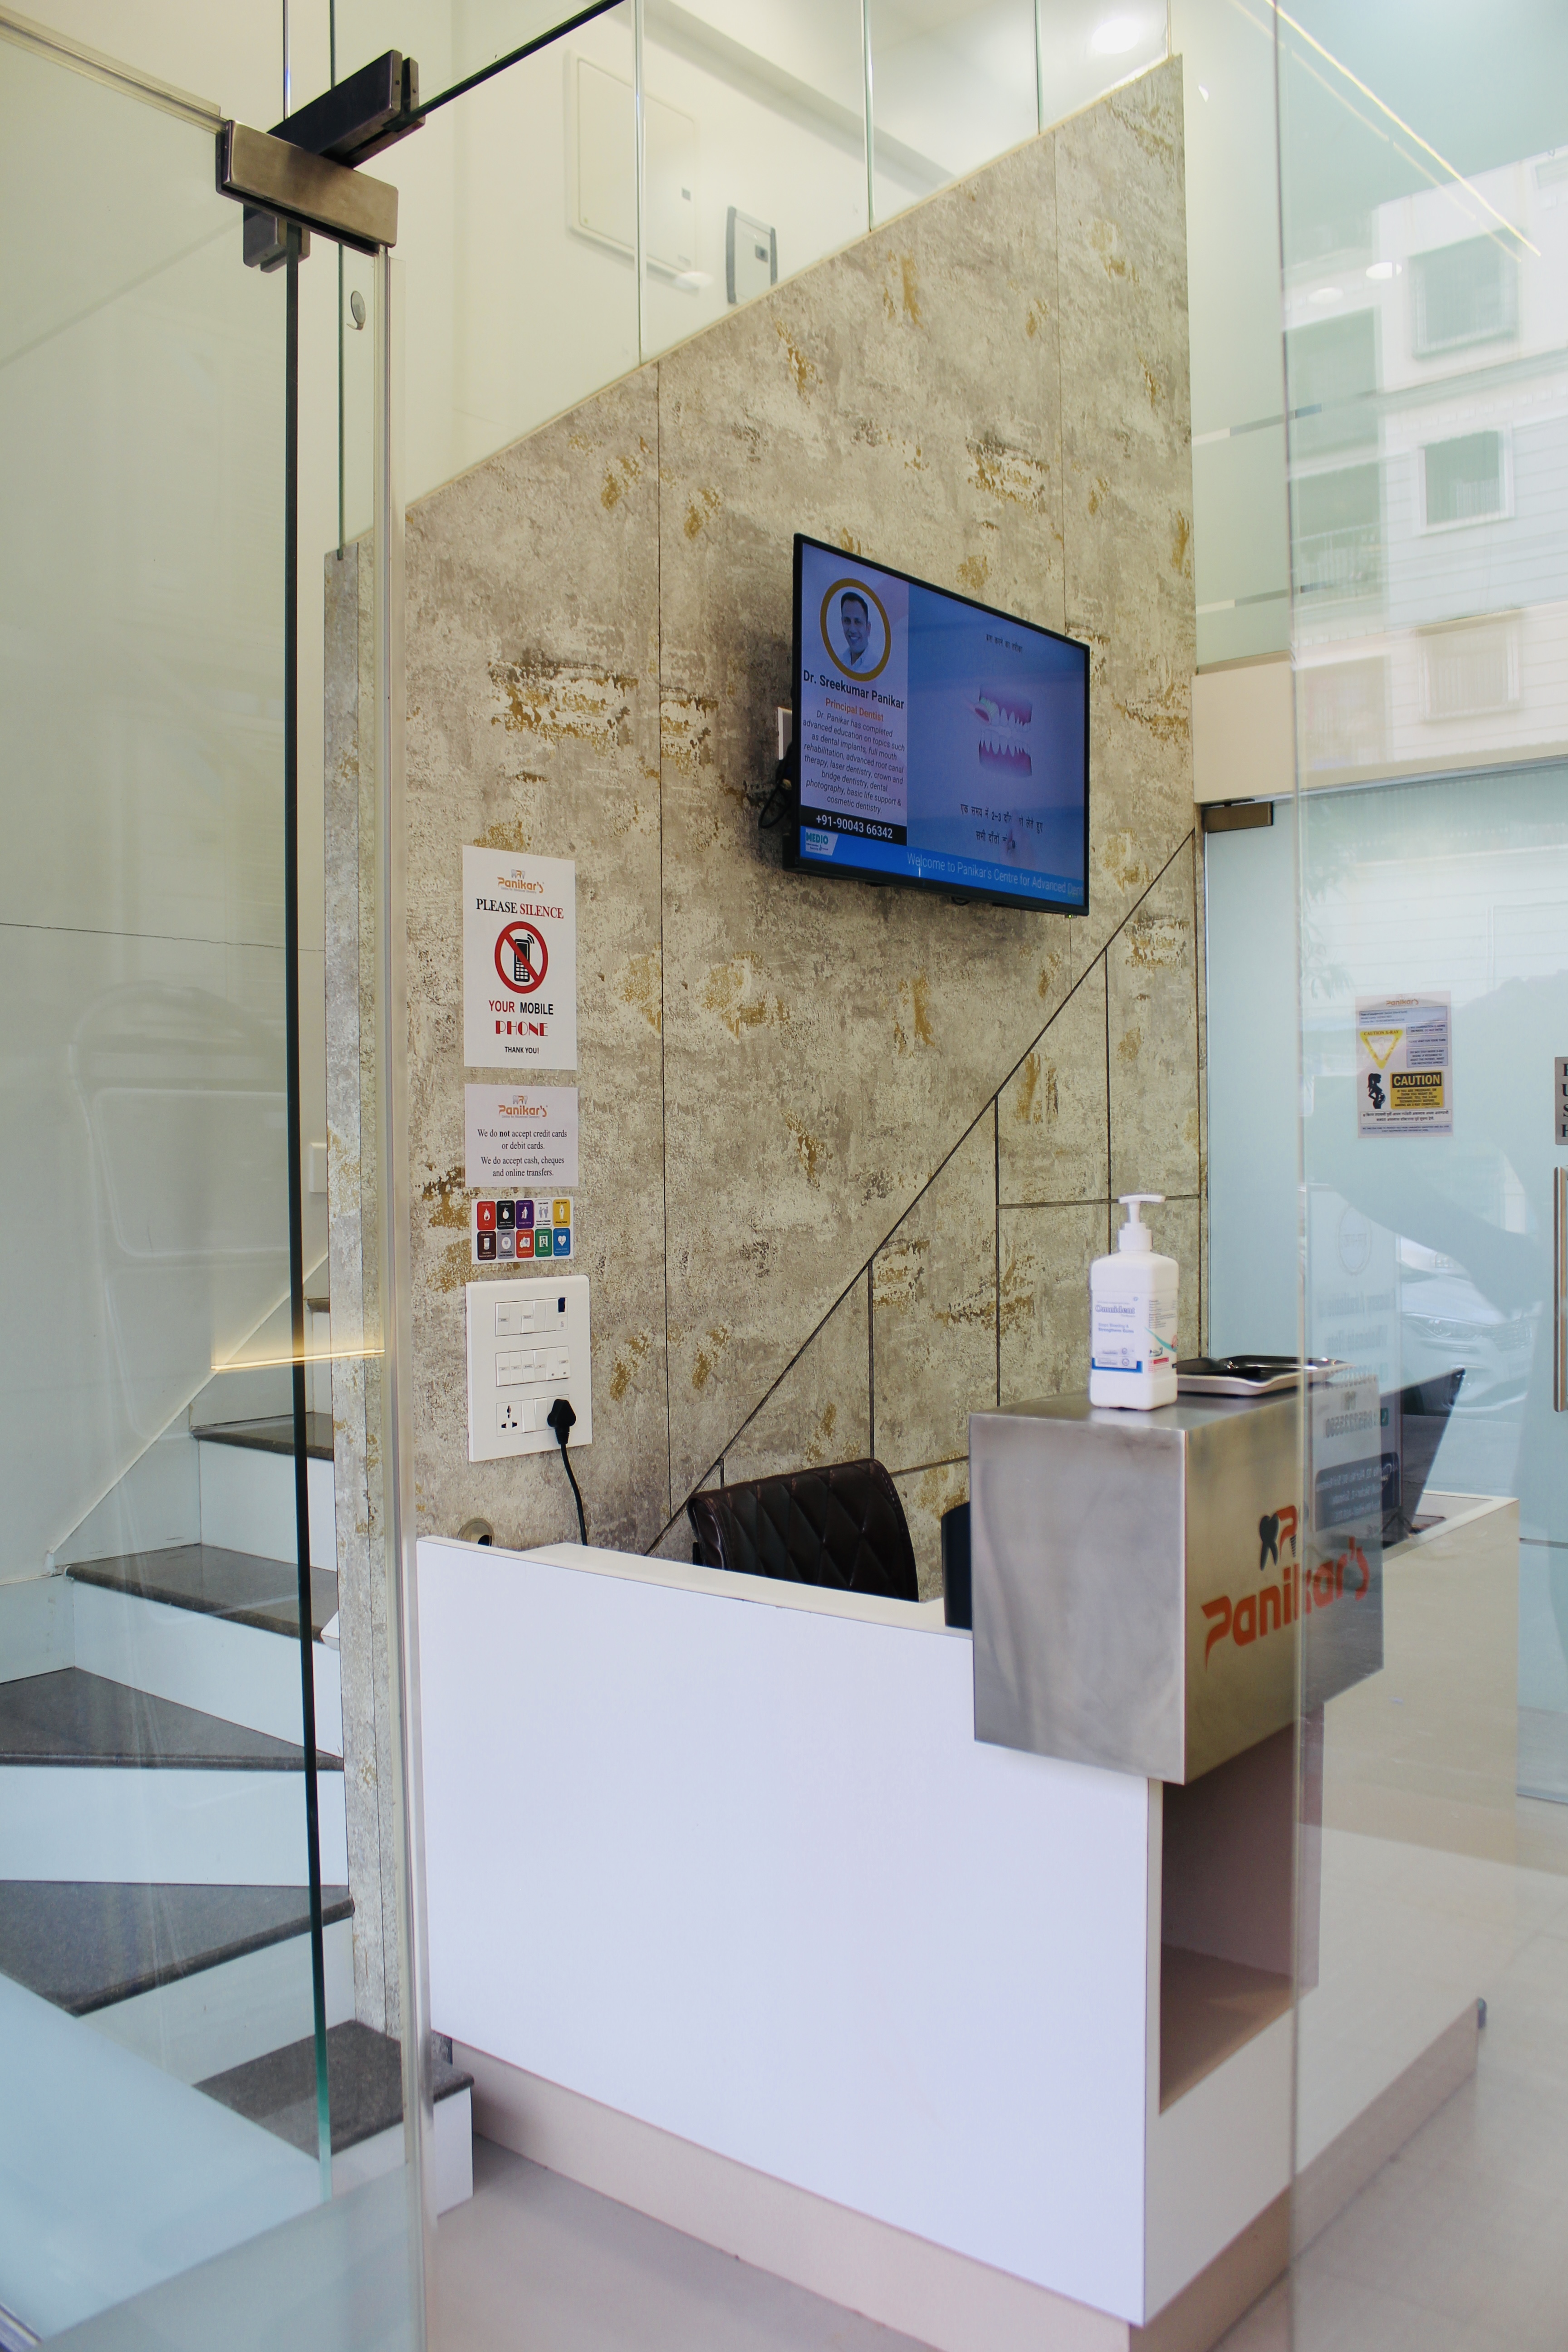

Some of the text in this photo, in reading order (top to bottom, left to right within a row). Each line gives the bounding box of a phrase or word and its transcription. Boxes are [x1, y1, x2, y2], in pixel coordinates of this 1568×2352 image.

[804, 670, 904, 709] Dr. Sreekumar Panikar
[825, 697, 884, 722] Principal Dentist
[803, 719, 832, 733] advanced
[834, 727, 862, 740] education
[873, 738, 890, 748] topics
[892, 743, 905, 751] such
[827, 713, 849, 725] Panikar
[851, 720, 861, 729] has
[862, 724, 893, 737] completed
[820, 735, 839, 746] dental
[840, 741, 867, 754] implants,
[868, 747, 877, 756] full
[879, 751, 897, 760] mouth
[804, 743, 904, 774] rehabilitation, advanced root canal
[805, 755, 828, 767] therapy,
[830, 760, 845, 770] laser
[846, 764, 872, 779] dentistry,
[874, 772, 891, 781] crown
[822, 770, 887, 792] bridge dentistry, dental
[806, 779, 845, 795] photography,
[847, 787, 862, 798] basic
[864, 791, 873, 799] life
[874, 795, 896, 805] support
[827, 796, 882, 814] cosmetic dentistry.
[960, 804, 969, 814] एक
[971, 806, 982, 818] समय
[816, 815, 892, 838] +91-90043 66342
[806, 832, 828, 844] MEDIO
[907, 852, 946, 870] Welcome
[947, 862, 955, 873] to
[958, 863, 992, 879] Panikar's
[994, 869, 1018, 884] Centre
[1020, 875, 1030, 886] for
[1032, 877, 1066, 893] Advanced
[497, 877, 544, 893] Panikar's
[476, 898, 564, 919] PLEASE SILENCE
[489, 1000, 554, 1015] YOUR MOBILE
[495, 1020, 548, 1037] PHONE
[1394, 1074, 1440, 1086] CAUTION
[498, 1105, 547, 1117] Panikar's
[477, 1129, 488, 1137] We
[512, 1130, 532, 1139] accept
[481, 1156, 491, 1164] We
[502, 1157, 522, 1166] accept
[524, 1156, 539, 1165] cash,
[541, 1156, 564, 1166] cheques
[1095, 1304, 1135, 1314] Omnident
